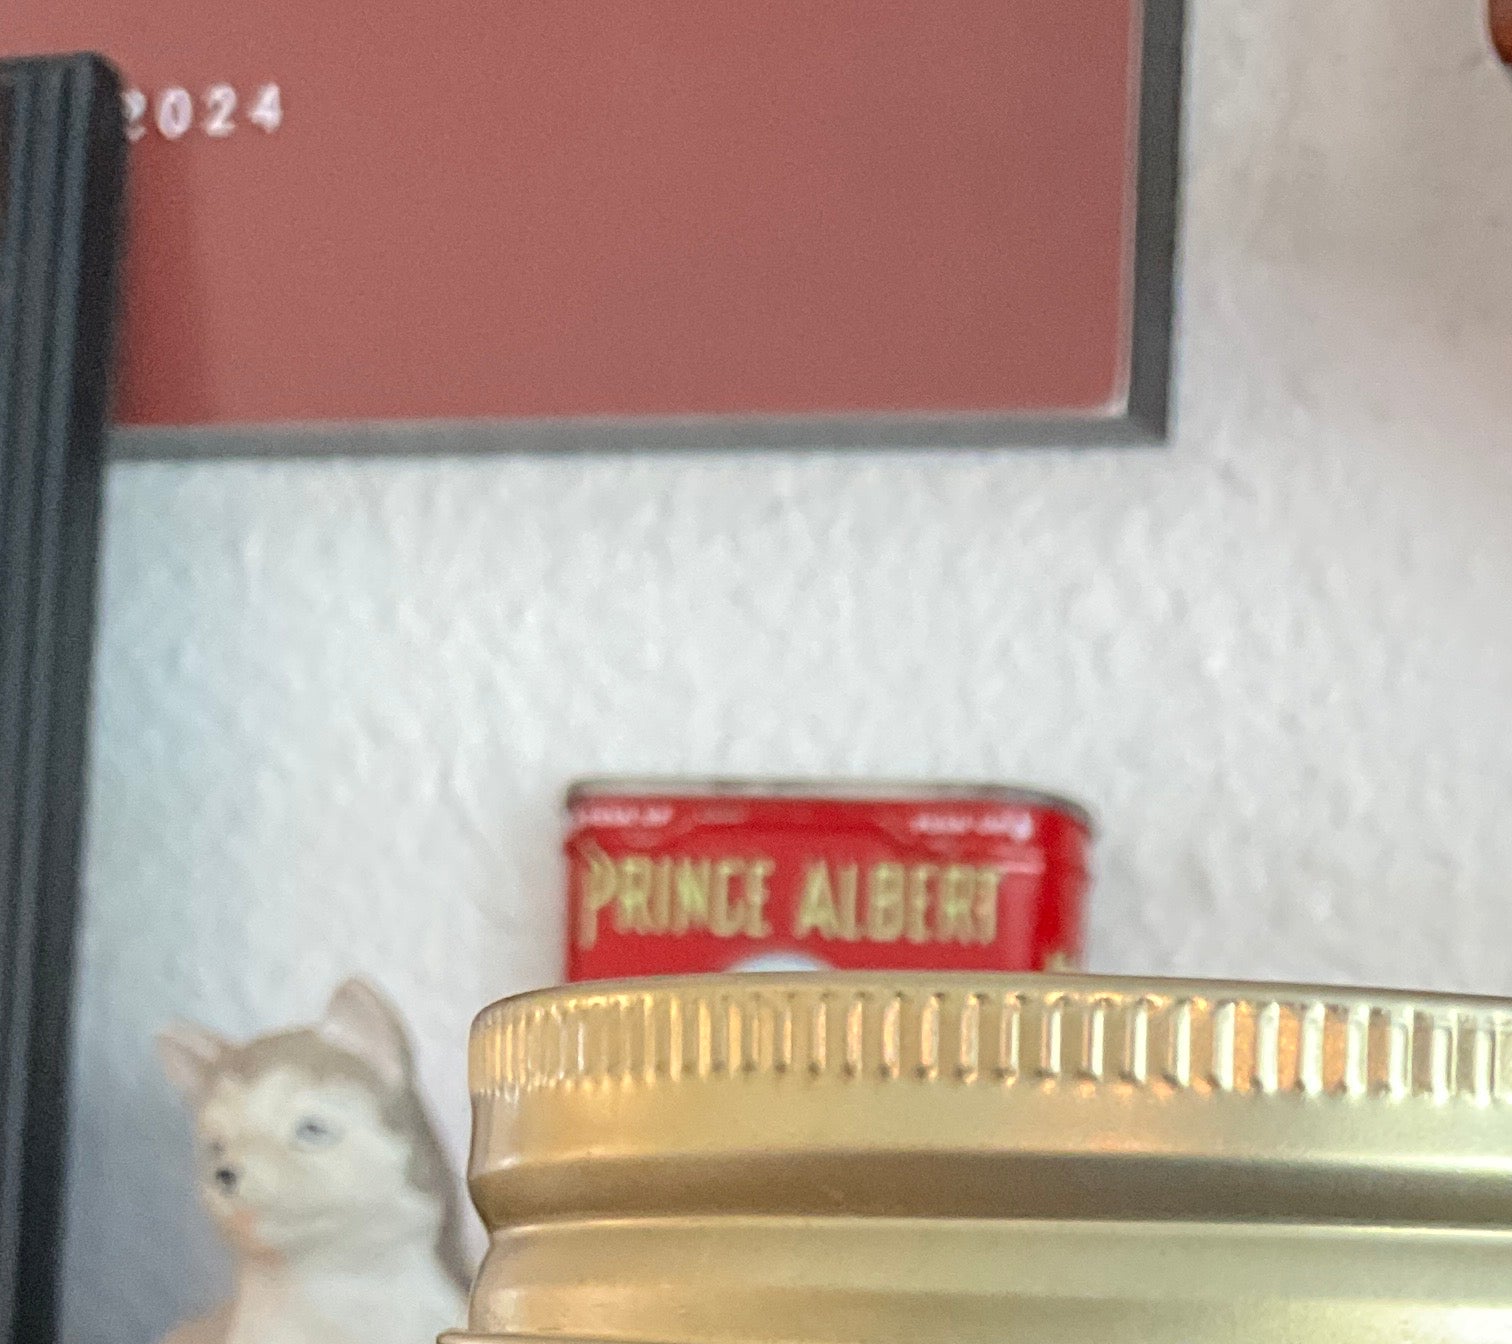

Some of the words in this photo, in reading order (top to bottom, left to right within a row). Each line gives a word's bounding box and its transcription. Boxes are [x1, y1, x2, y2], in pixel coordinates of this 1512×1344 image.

[121, 80, 284, 143] 2024
[578, 842, 774, 949] PRINCE
[796, 858, 1002, 945] ALBERT
